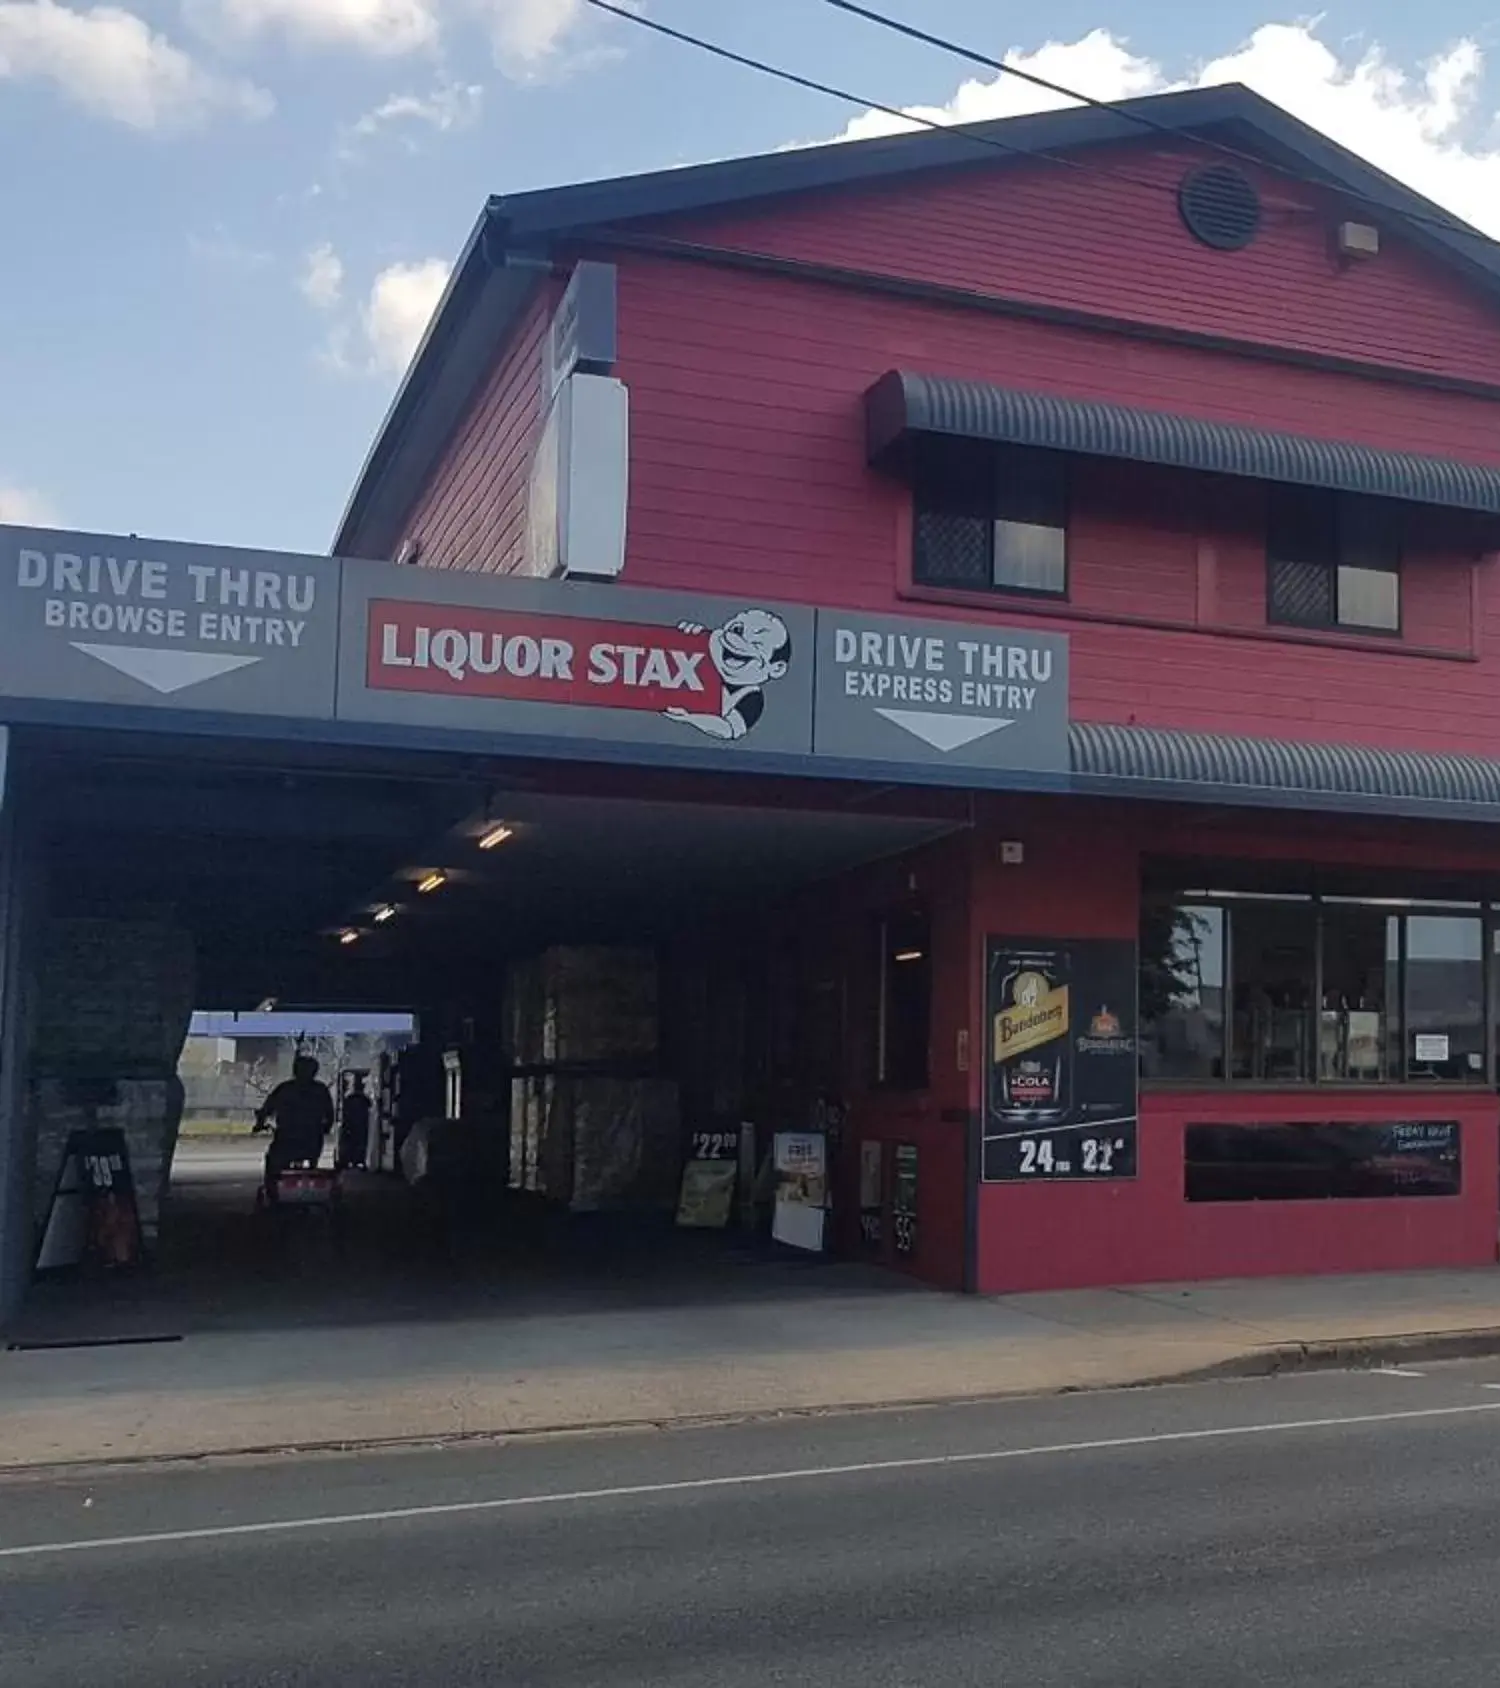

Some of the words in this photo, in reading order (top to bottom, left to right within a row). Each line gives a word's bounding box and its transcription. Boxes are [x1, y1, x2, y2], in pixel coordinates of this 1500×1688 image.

[17, 549, 168, 598] DRIVE
[188, 564, 316, 612] THRU
[45, 599, 186, 638] BROWSE
[200, 612, 306, 648] ENTRY
[381, 623, 575, 682] LIQUOR
[587, 642, 705, 692] STAX
[834, 629, 945, 672] DRIVE
[957, 641, 1053, 682] THRU
[844, 670, 953, 705] EXPRESS
[961, 681, 1037, 711] ENTRY
[1019, 1138, 1054, 1173] 24
